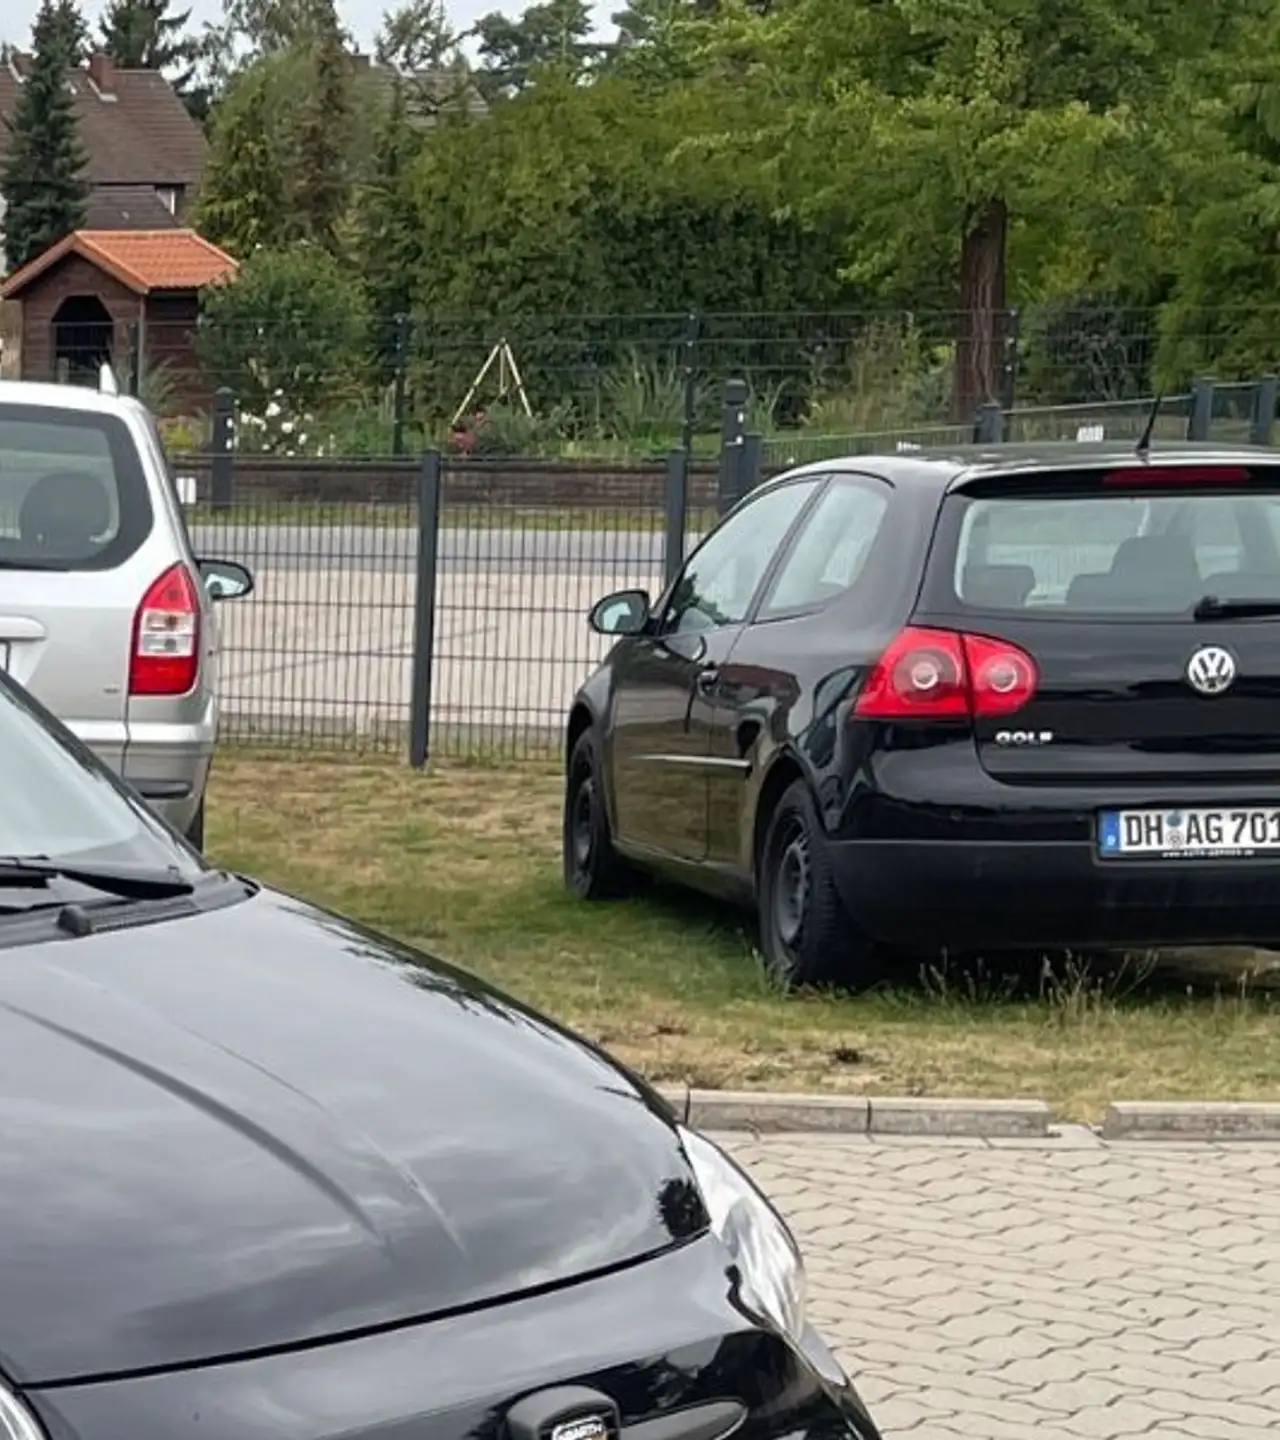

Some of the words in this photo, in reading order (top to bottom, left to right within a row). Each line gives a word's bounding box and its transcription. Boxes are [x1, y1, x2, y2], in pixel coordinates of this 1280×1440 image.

[996, 731, 1052, 744] GOLF
[1125, 814, 1164, 846] DH
[1187, 813, 1224, 845] AG
